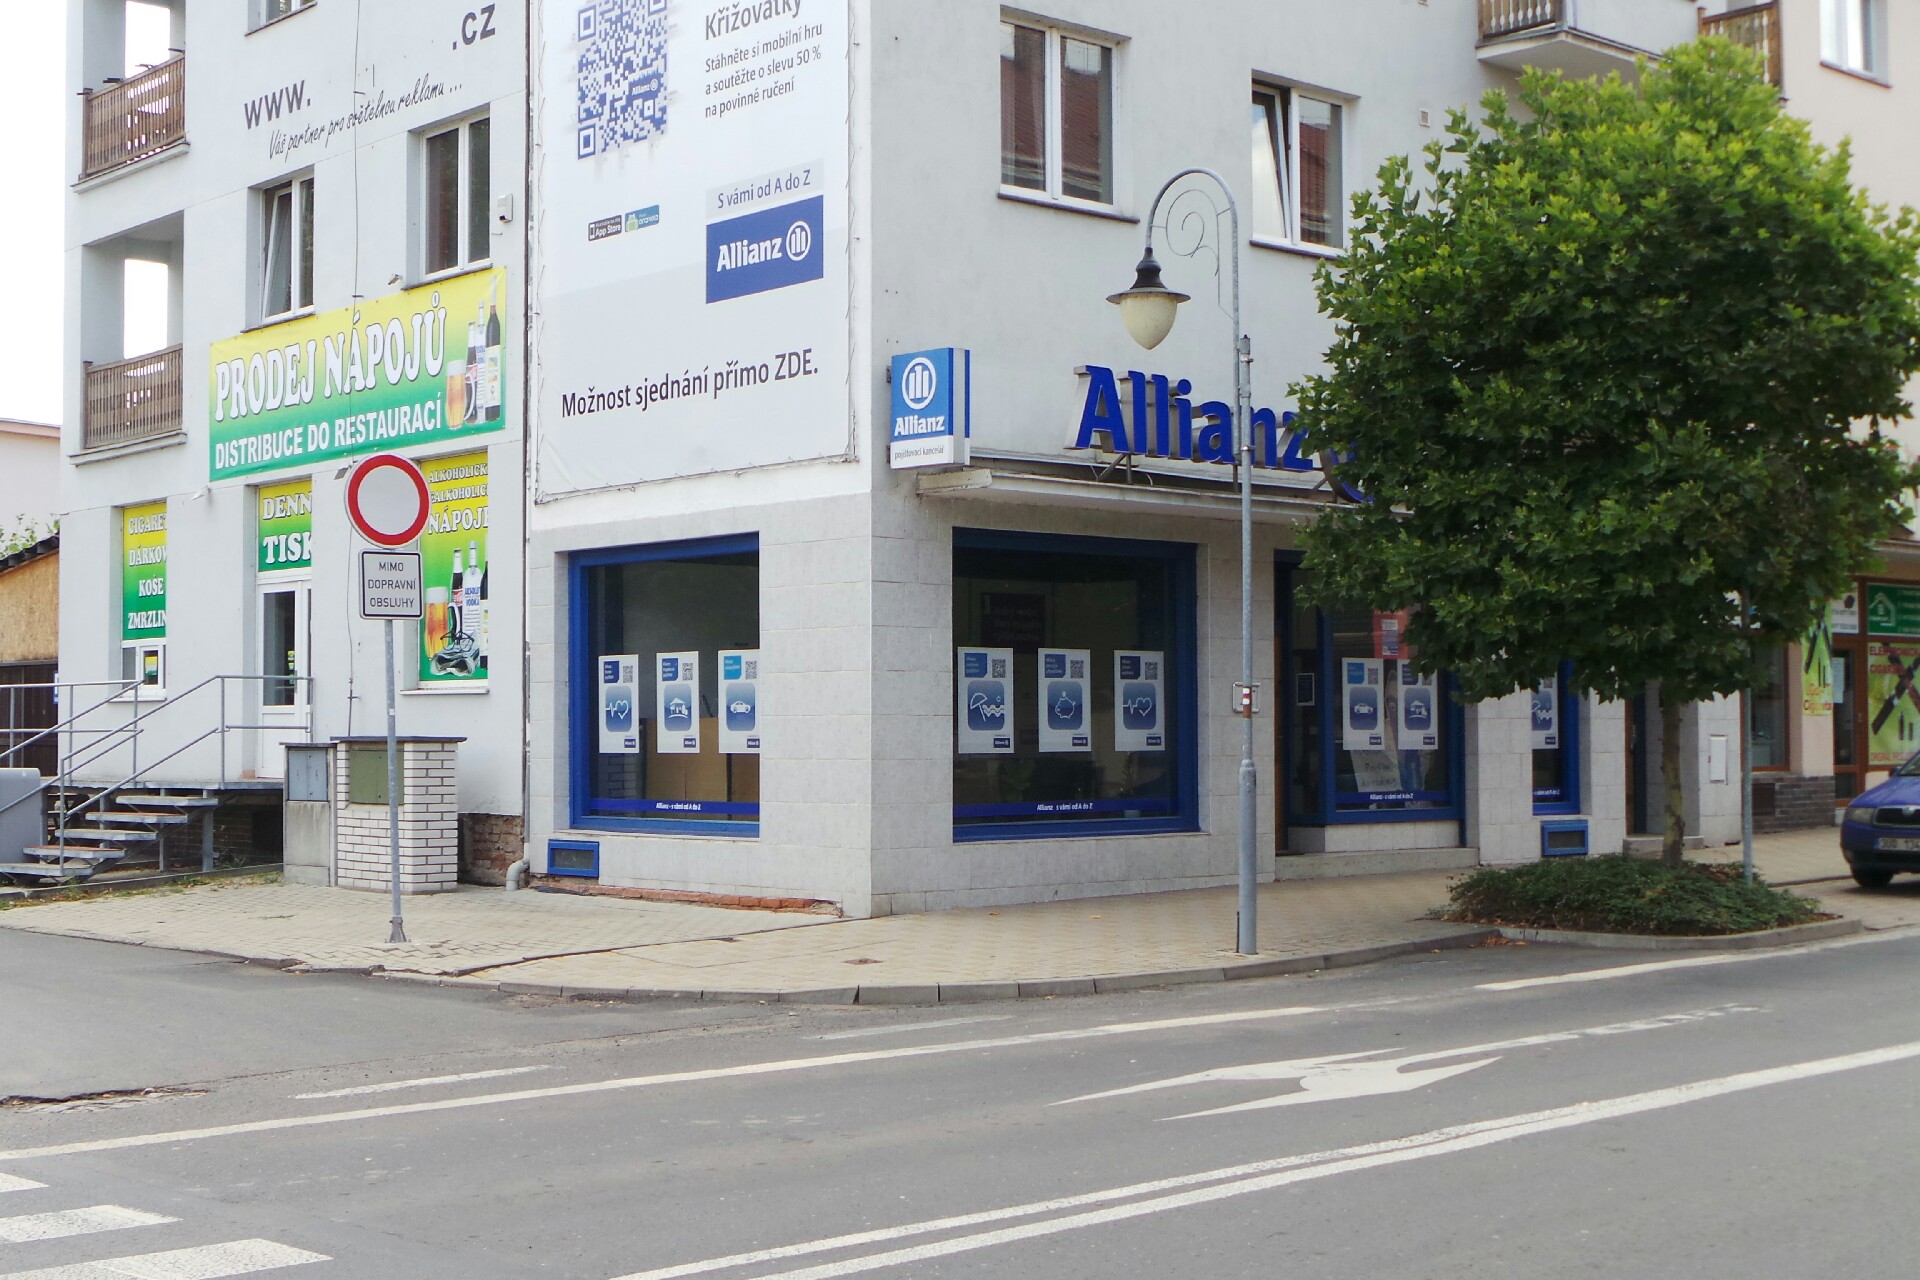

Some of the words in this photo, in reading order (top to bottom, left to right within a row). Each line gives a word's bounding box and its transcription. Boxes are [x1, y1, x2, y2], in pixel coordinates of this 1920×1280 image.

[705, 47, 749, 73] Stáhněte
[752, 41, 760, 58] si
[762, 26, 802, 54] mobilní
[804, 24, 823, 40] hru
[705, 84, 711, 95] a
[713, 67, 756, 93] soutěžte
[758, 66, 765, 78] o
[767, 57, 794, 76] slevu
[796, 48, 810, 66] 50
[812, 44, 821, 61] %
[269, 129, 288, 160] Váš
[284, 121, 327, 163] partner
[324, 116, 345, 148] pro
[397, 72, 445, 111] reklamu
[705, 104, 717, 118] na
[719, 87, 760, 118] povinné
[762, 75, 795, 100] ručení
[717, 192, 724, 209] S
[726, 184, 754, 206] vámi
[757, 178, 771, 198] od
[774, 177, 782, 194] A
[785, 172, 800, 190] do
[803, 169, 811, 186] Z
[716, 237, 783, 272] Allianz
[215, 339, 317, 422] PRODEJ
[323, 290, 447, 398] NÁPOJŮ
[561, 384, 631, 418] Možnost
[634, 365, 709, 412] sjednání
[713, 360, 769, 399] přímo
[774, 348, 818, 381] ZDE.
[215, 425, 303, 470] DISTRIBUCE
[307, 421, 330, 453] DO
[334, 391, 442, 447] RESTAURACÍ
[894, 415, 945, 437] Allianz
[1074, 364, 1313, 472] Allianz
[430, 483, 488, 504] EALKOHOLIC
[367, 577, 416, 590] DOPRAVNÍ
[378, 561, 404, 572] MIMO
[369, 597, 414, 609] OBSLUHY
